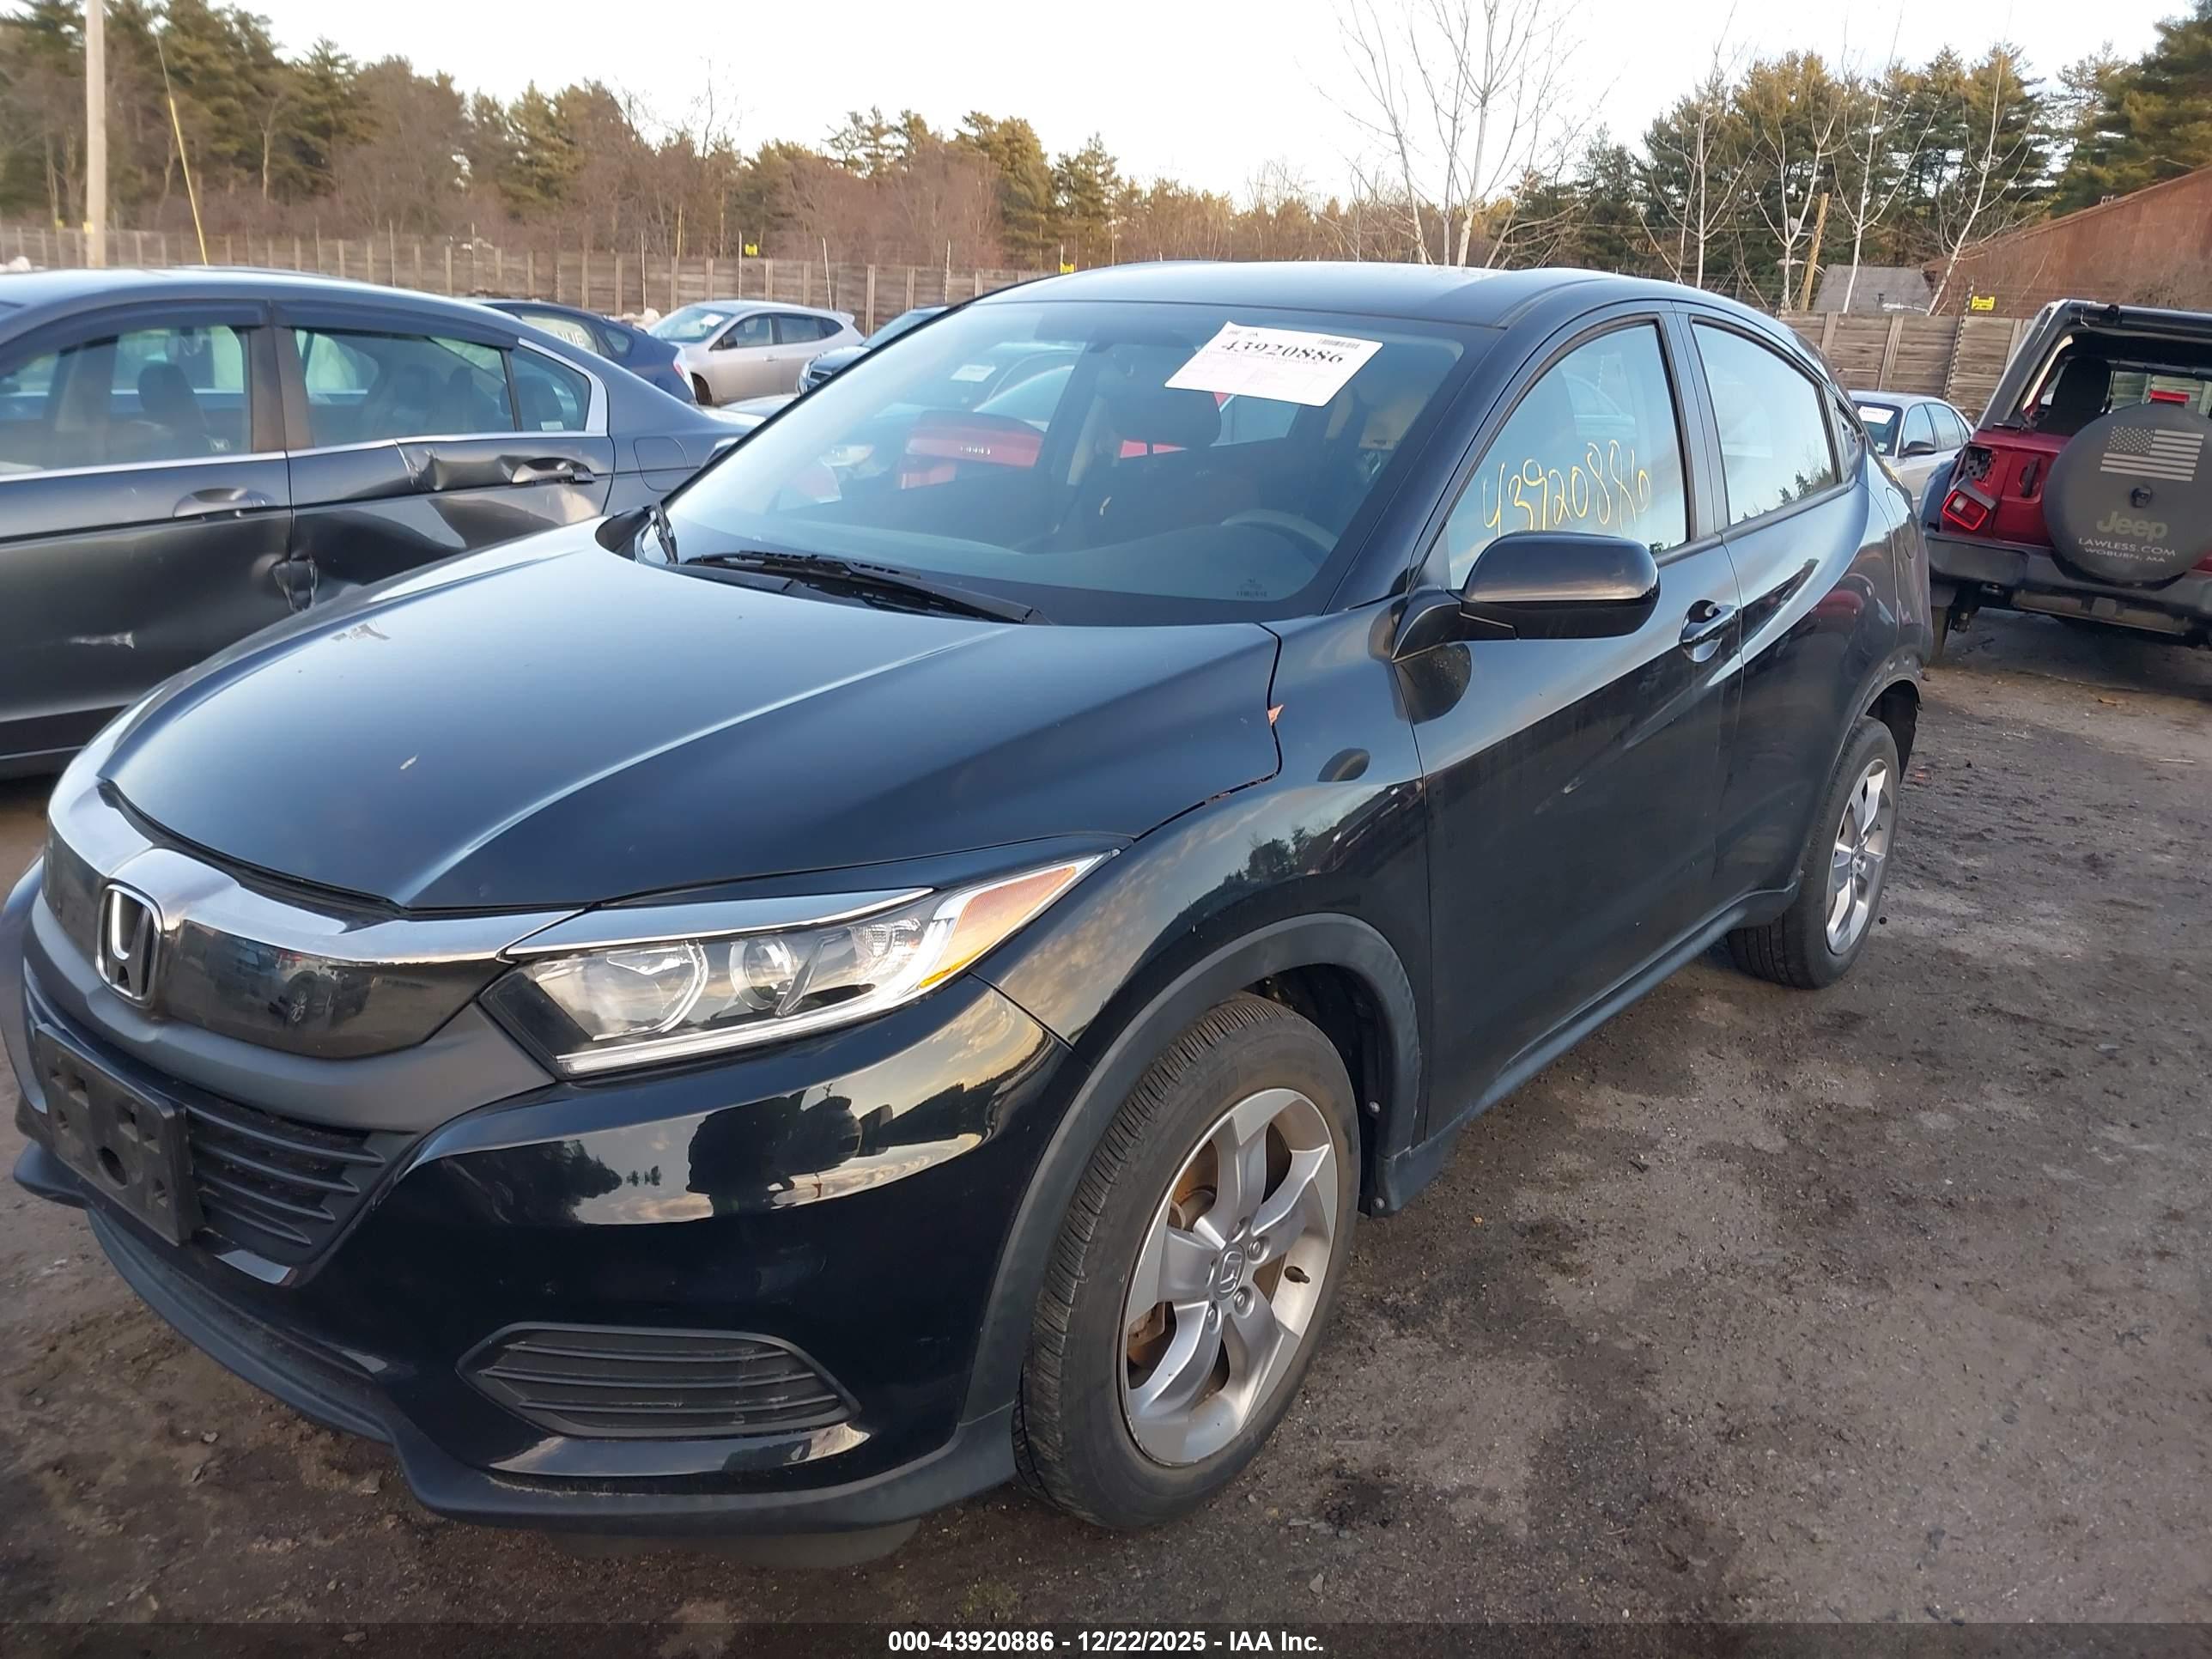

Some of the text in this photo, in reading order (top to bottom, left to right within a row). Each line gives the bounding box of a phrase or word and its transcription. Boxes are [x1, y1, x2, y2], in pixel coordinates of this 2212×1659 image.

[1482, 439, 1650, 537] 43920886
[2096, 511, 2168, 542] Jeep
[2078, 538, 2176, 557] LAWLESS.COM
